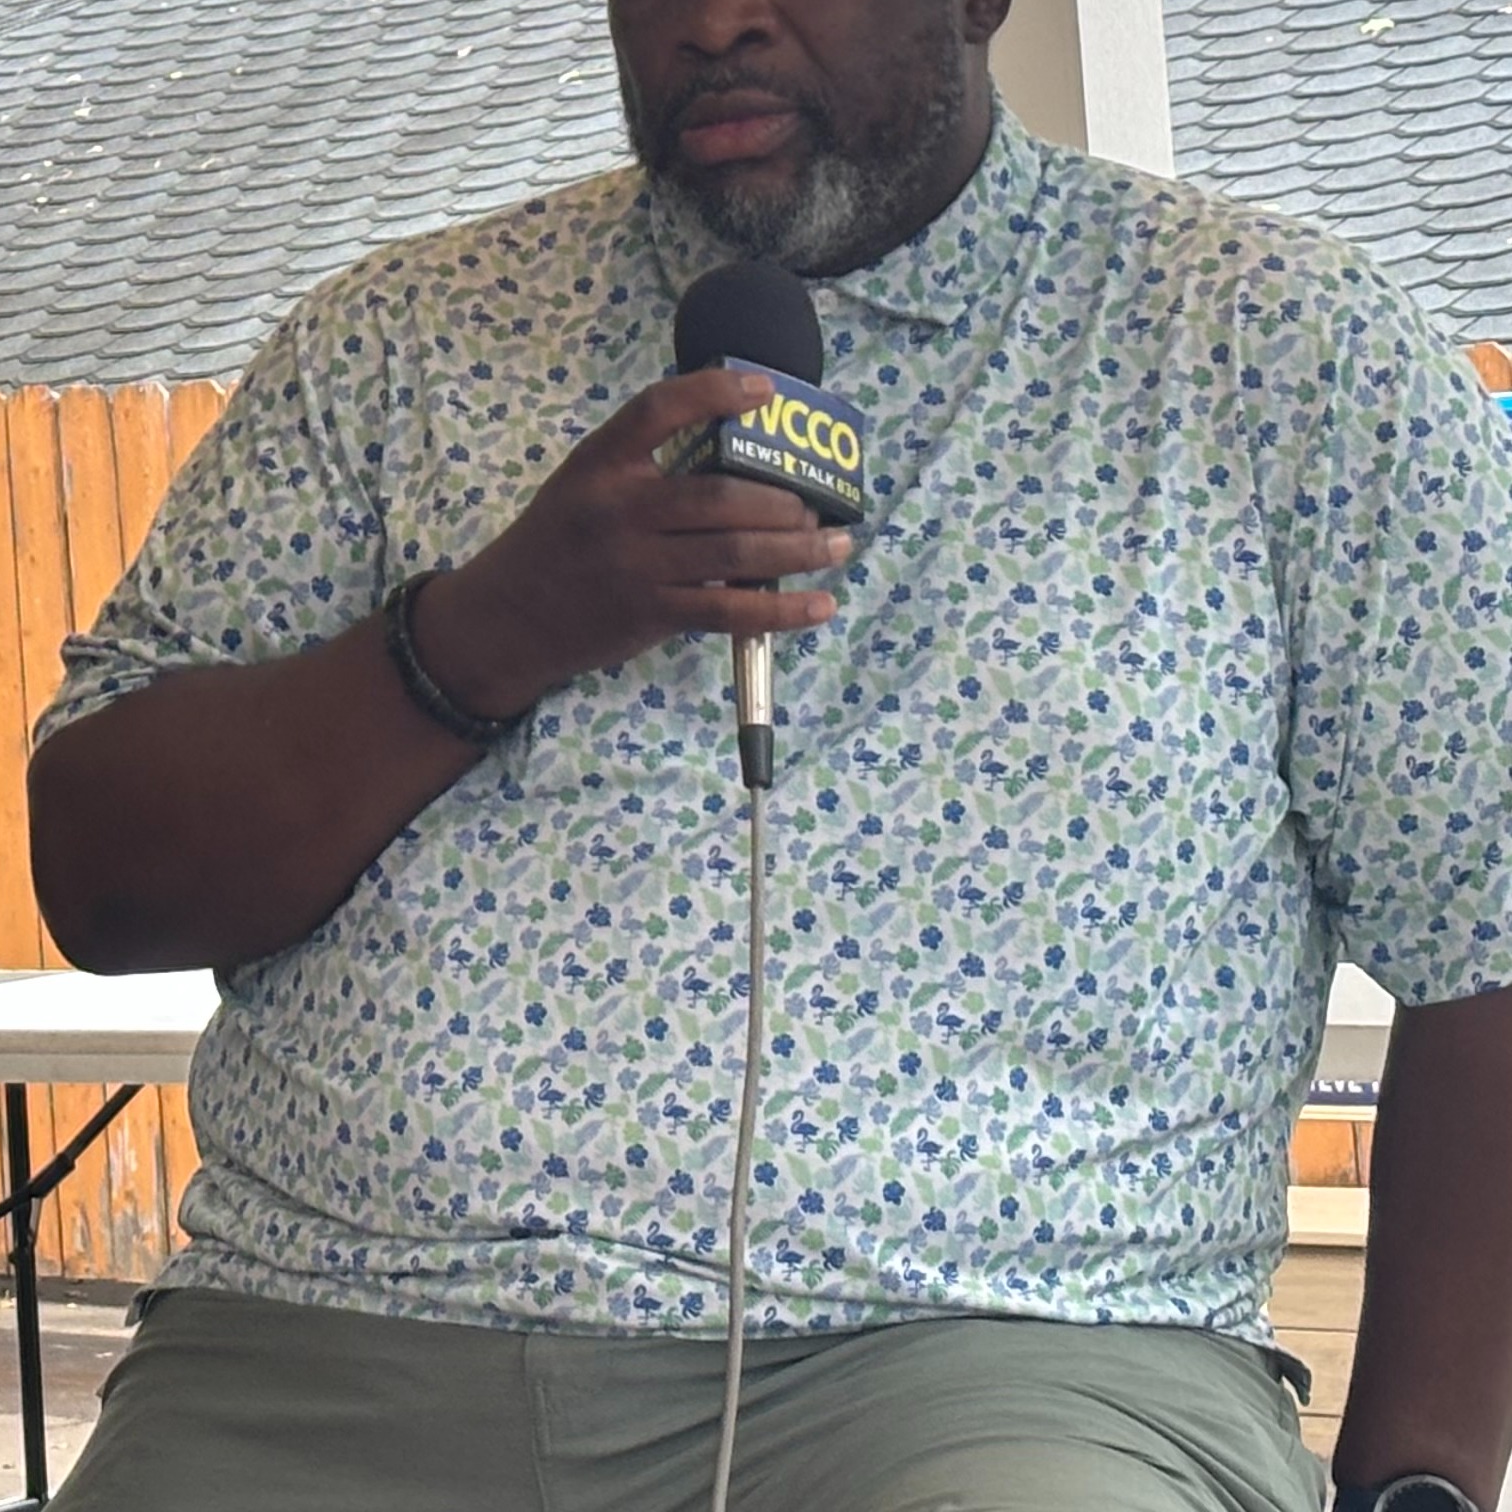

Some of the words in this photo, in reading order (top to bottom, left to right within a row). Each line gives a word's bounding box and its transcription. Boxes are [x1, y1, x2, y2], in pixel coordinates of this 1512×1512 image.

[740, 394, 861, 472] WCCO
[732, 436, 782, 466] NEWS
[799, 460, 835, 489] TALK
[836, 478, 861, 503] 830
